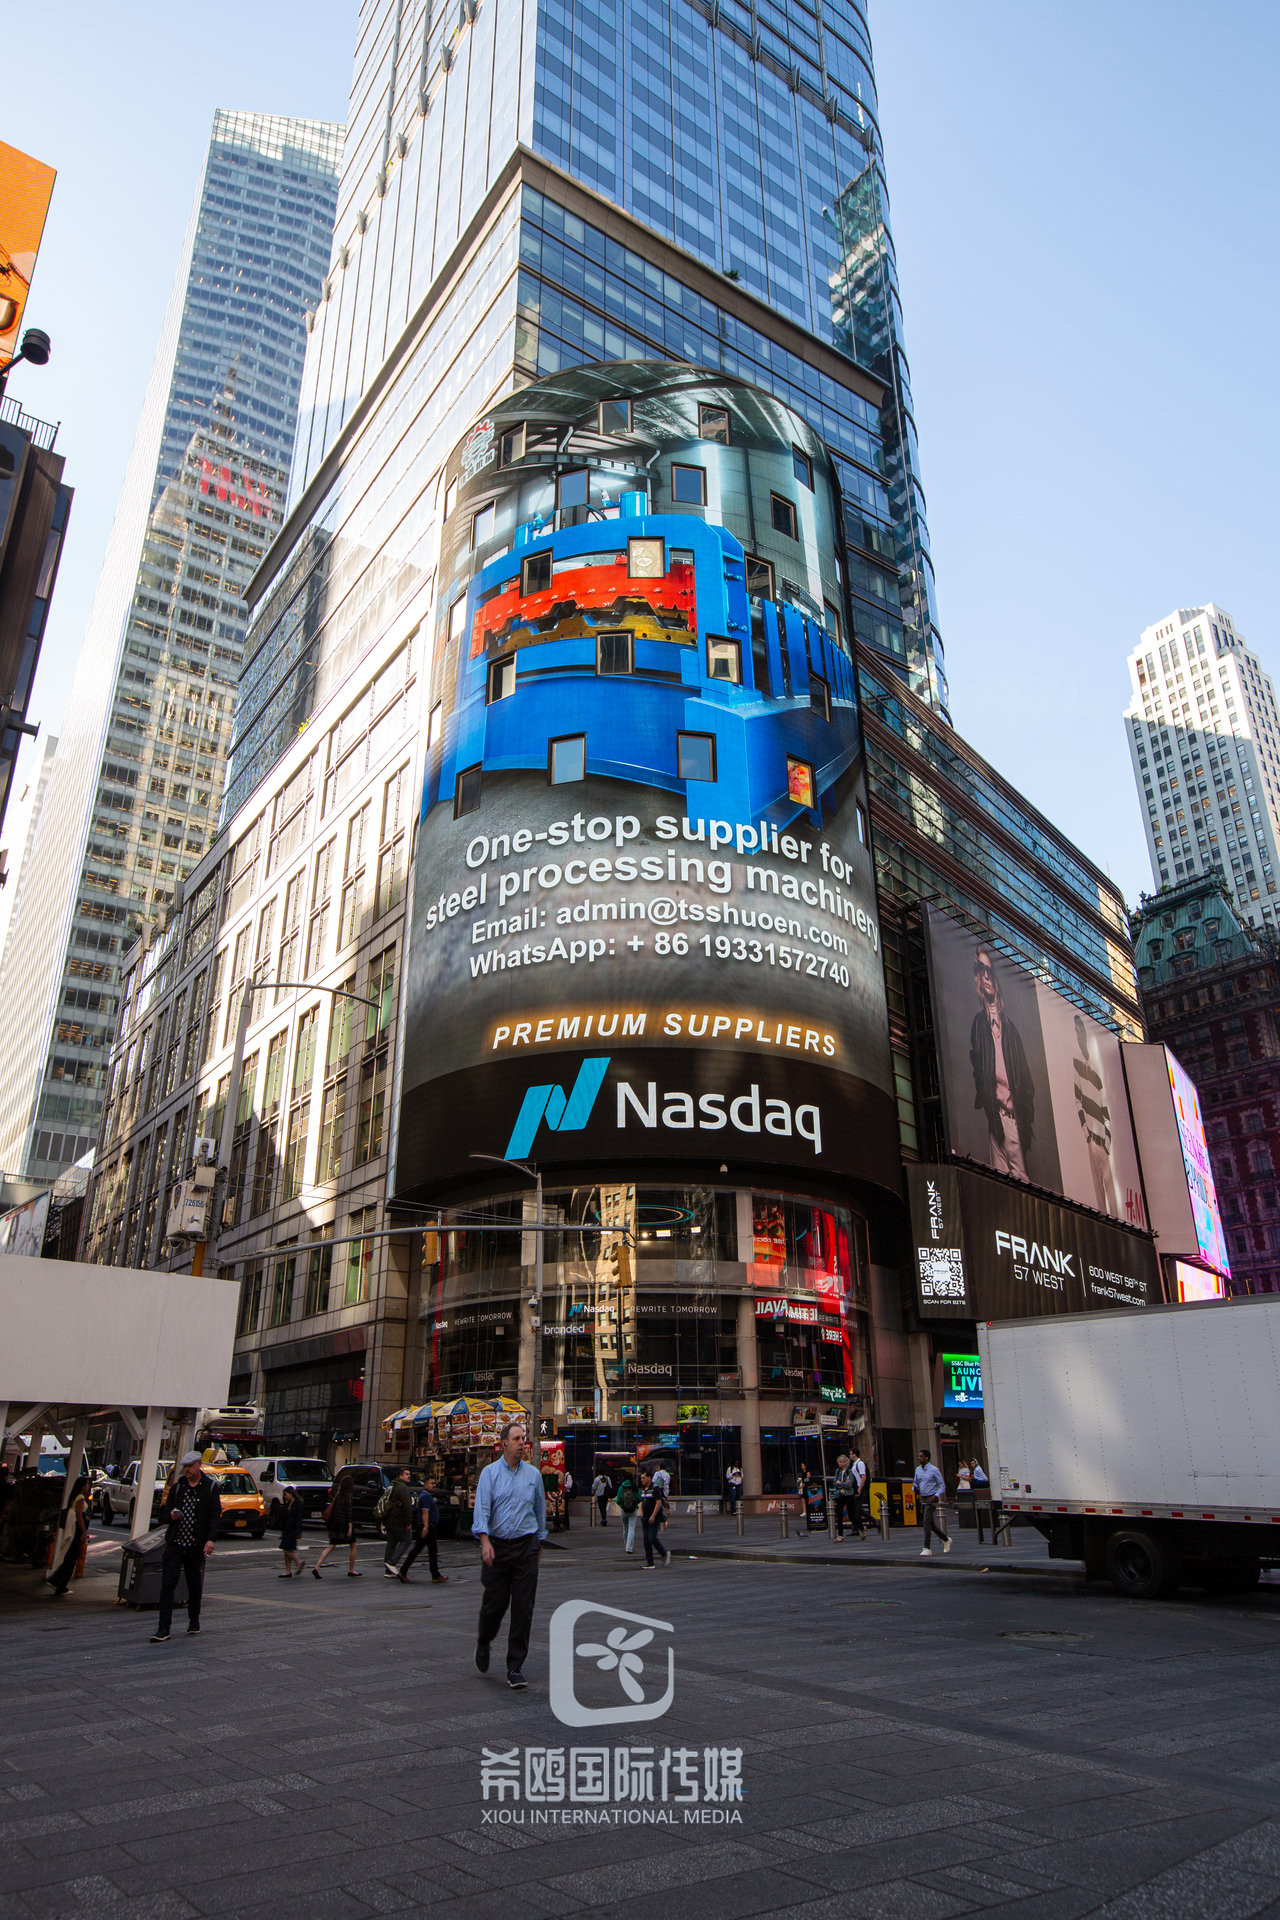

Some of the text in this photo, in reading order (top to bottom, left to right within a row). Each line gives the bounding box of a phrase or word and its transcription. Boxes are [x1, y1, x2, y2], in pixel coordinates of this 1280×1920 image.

[466, 812, 853, 885] One-stop supplier for
[426, 849, 878, 952] steel processing machinery
[472, 897, 849, 955] Email: admin@tsshuoen.com
[470, 932, 850, 988] WhatsApp: + 86 19331572740
[492, 1013, 836, 1057] PREMIUM SUPPLIERS
[616, 1081, 823, 1155] Nasdaq
[926, 1180, 940, 1240] FRANK
[1125, 1187, 1145, 1228] H&M
[995, 1230, 1077, 1278] FRANK
[1014, 1264, 1064, 1291] 57 WEST
[1088, 1265, 1104, 1279] 600
[1104, 1270, 1123, 1285] WEST
[1139, 1281, 1147, 1292] ST
[1091, 1282, 1146, 1307] frank57west.com
[477, 1312, 512, 1322] TOMORROW
[583, 1304, 718, 1314] Nasdaq REWRITE TOMORROW
[627, 1363, 672, 1376] Nasdaq
[951, 1367, 981, 1376] LAUNC
